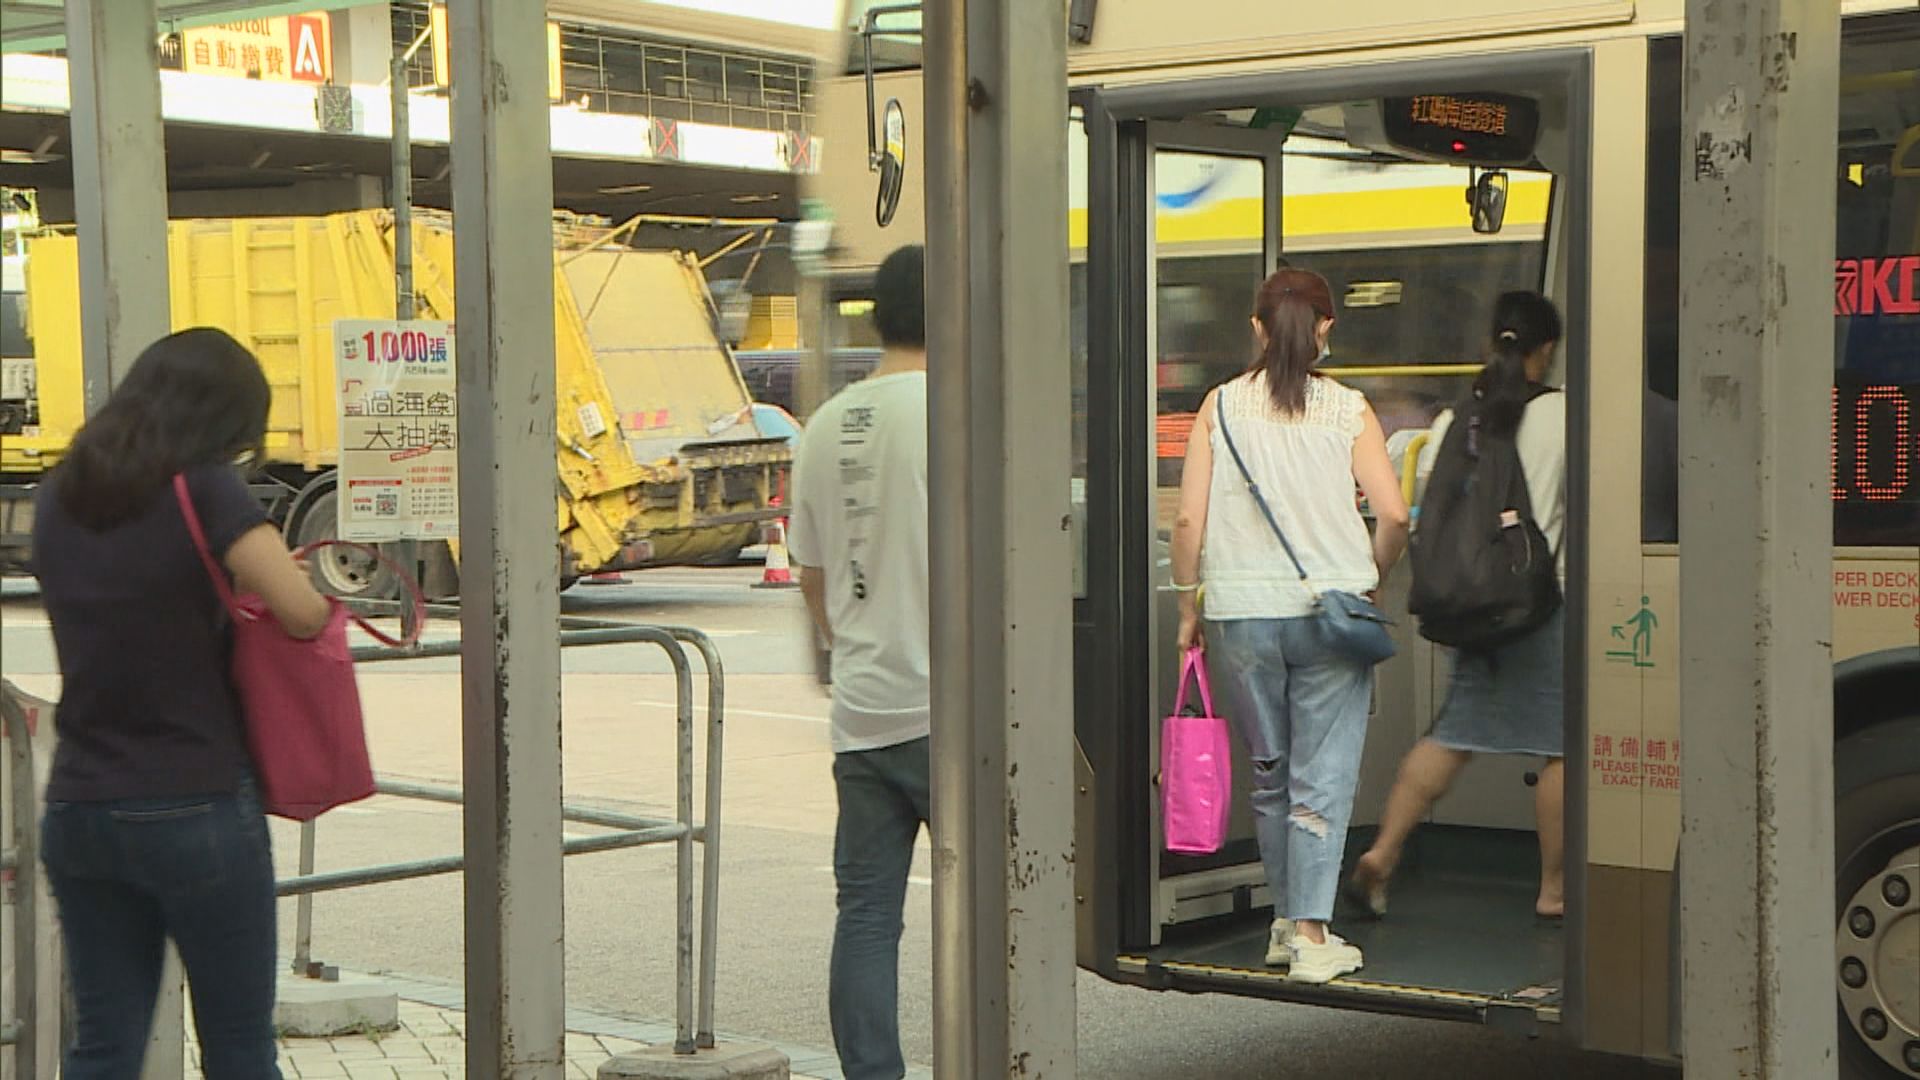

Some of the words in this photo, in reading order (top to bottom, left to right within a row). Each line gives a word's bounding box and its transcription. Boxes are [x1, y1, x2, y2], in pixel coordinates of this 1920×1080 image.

[1873, 572, 1918, 587] DECK
[1593, 760, 1638, 773] PLEASE
[1644, 763, 1680, 777] TEND
[1602, 775, 1645, 787] EXACT
